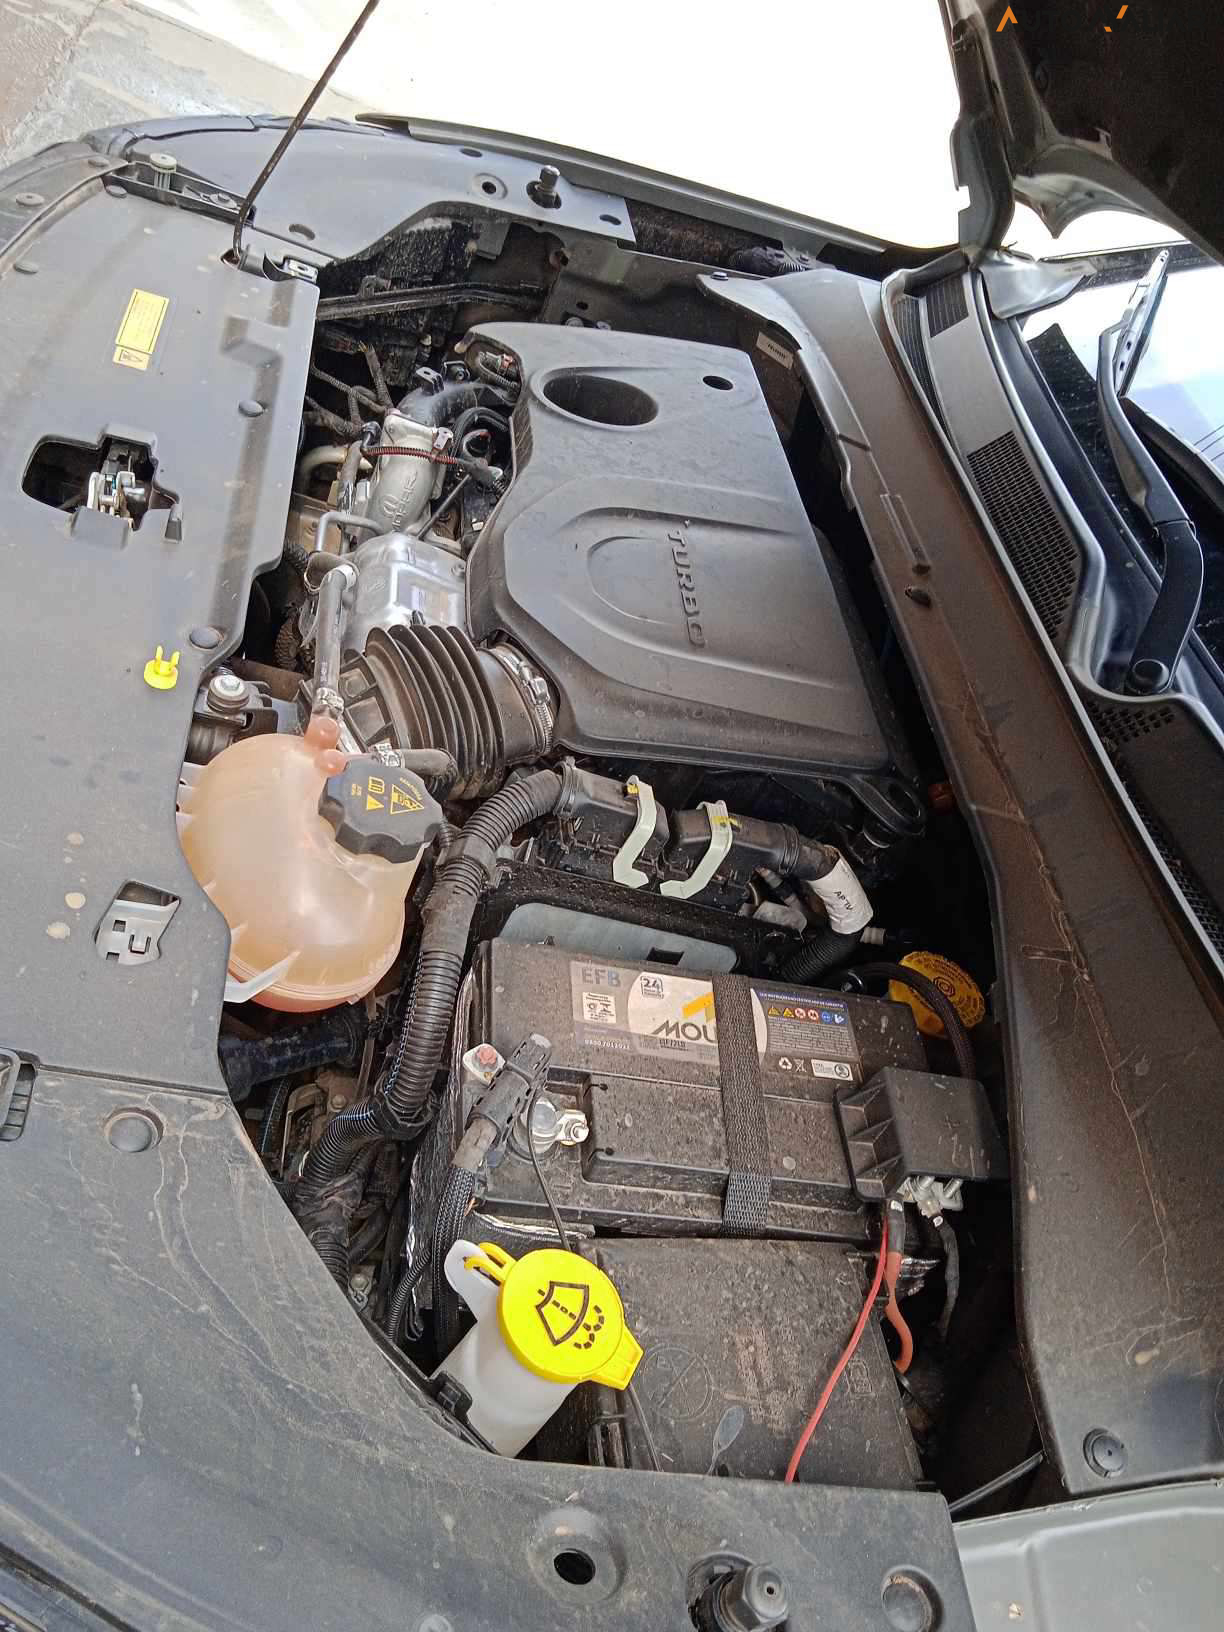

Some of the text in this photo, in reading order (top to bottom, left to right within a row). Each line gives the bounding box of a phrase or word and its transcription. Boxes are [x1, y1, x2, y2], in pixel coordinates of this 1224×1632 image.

[666, 519, 706, 648] TURBO
[581, 967, 622, 987] EFB
[642, 978, 661, 991] 24
